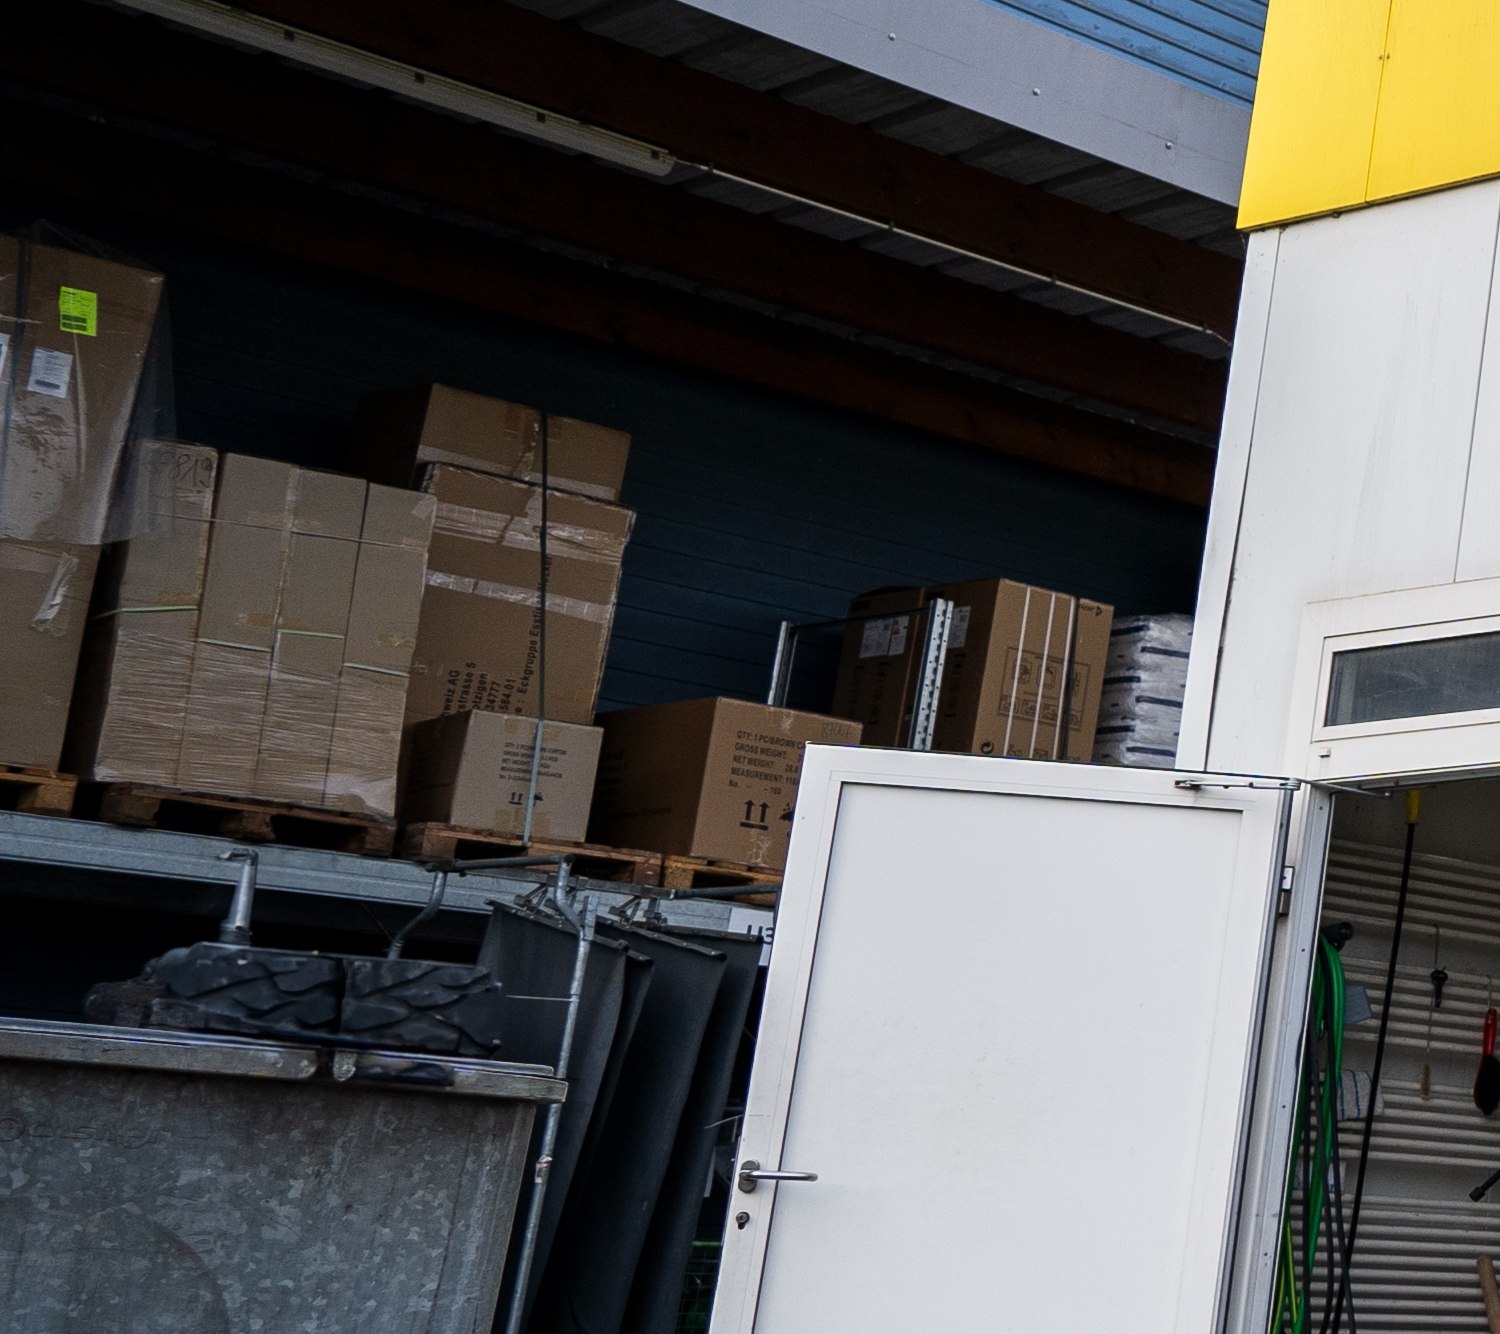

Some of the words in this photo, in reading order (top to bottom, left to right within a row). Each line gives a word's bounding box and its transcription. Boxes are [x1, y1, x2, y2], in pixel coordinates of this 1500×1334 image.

[517, 638, 538, 694] Eckgruppe
[448, 669, 460, 685] AG
[736, 730, 753, 740] QTY:
[735, 742, 759, 755] GROSS
[733, 754, 747, 764] NET
